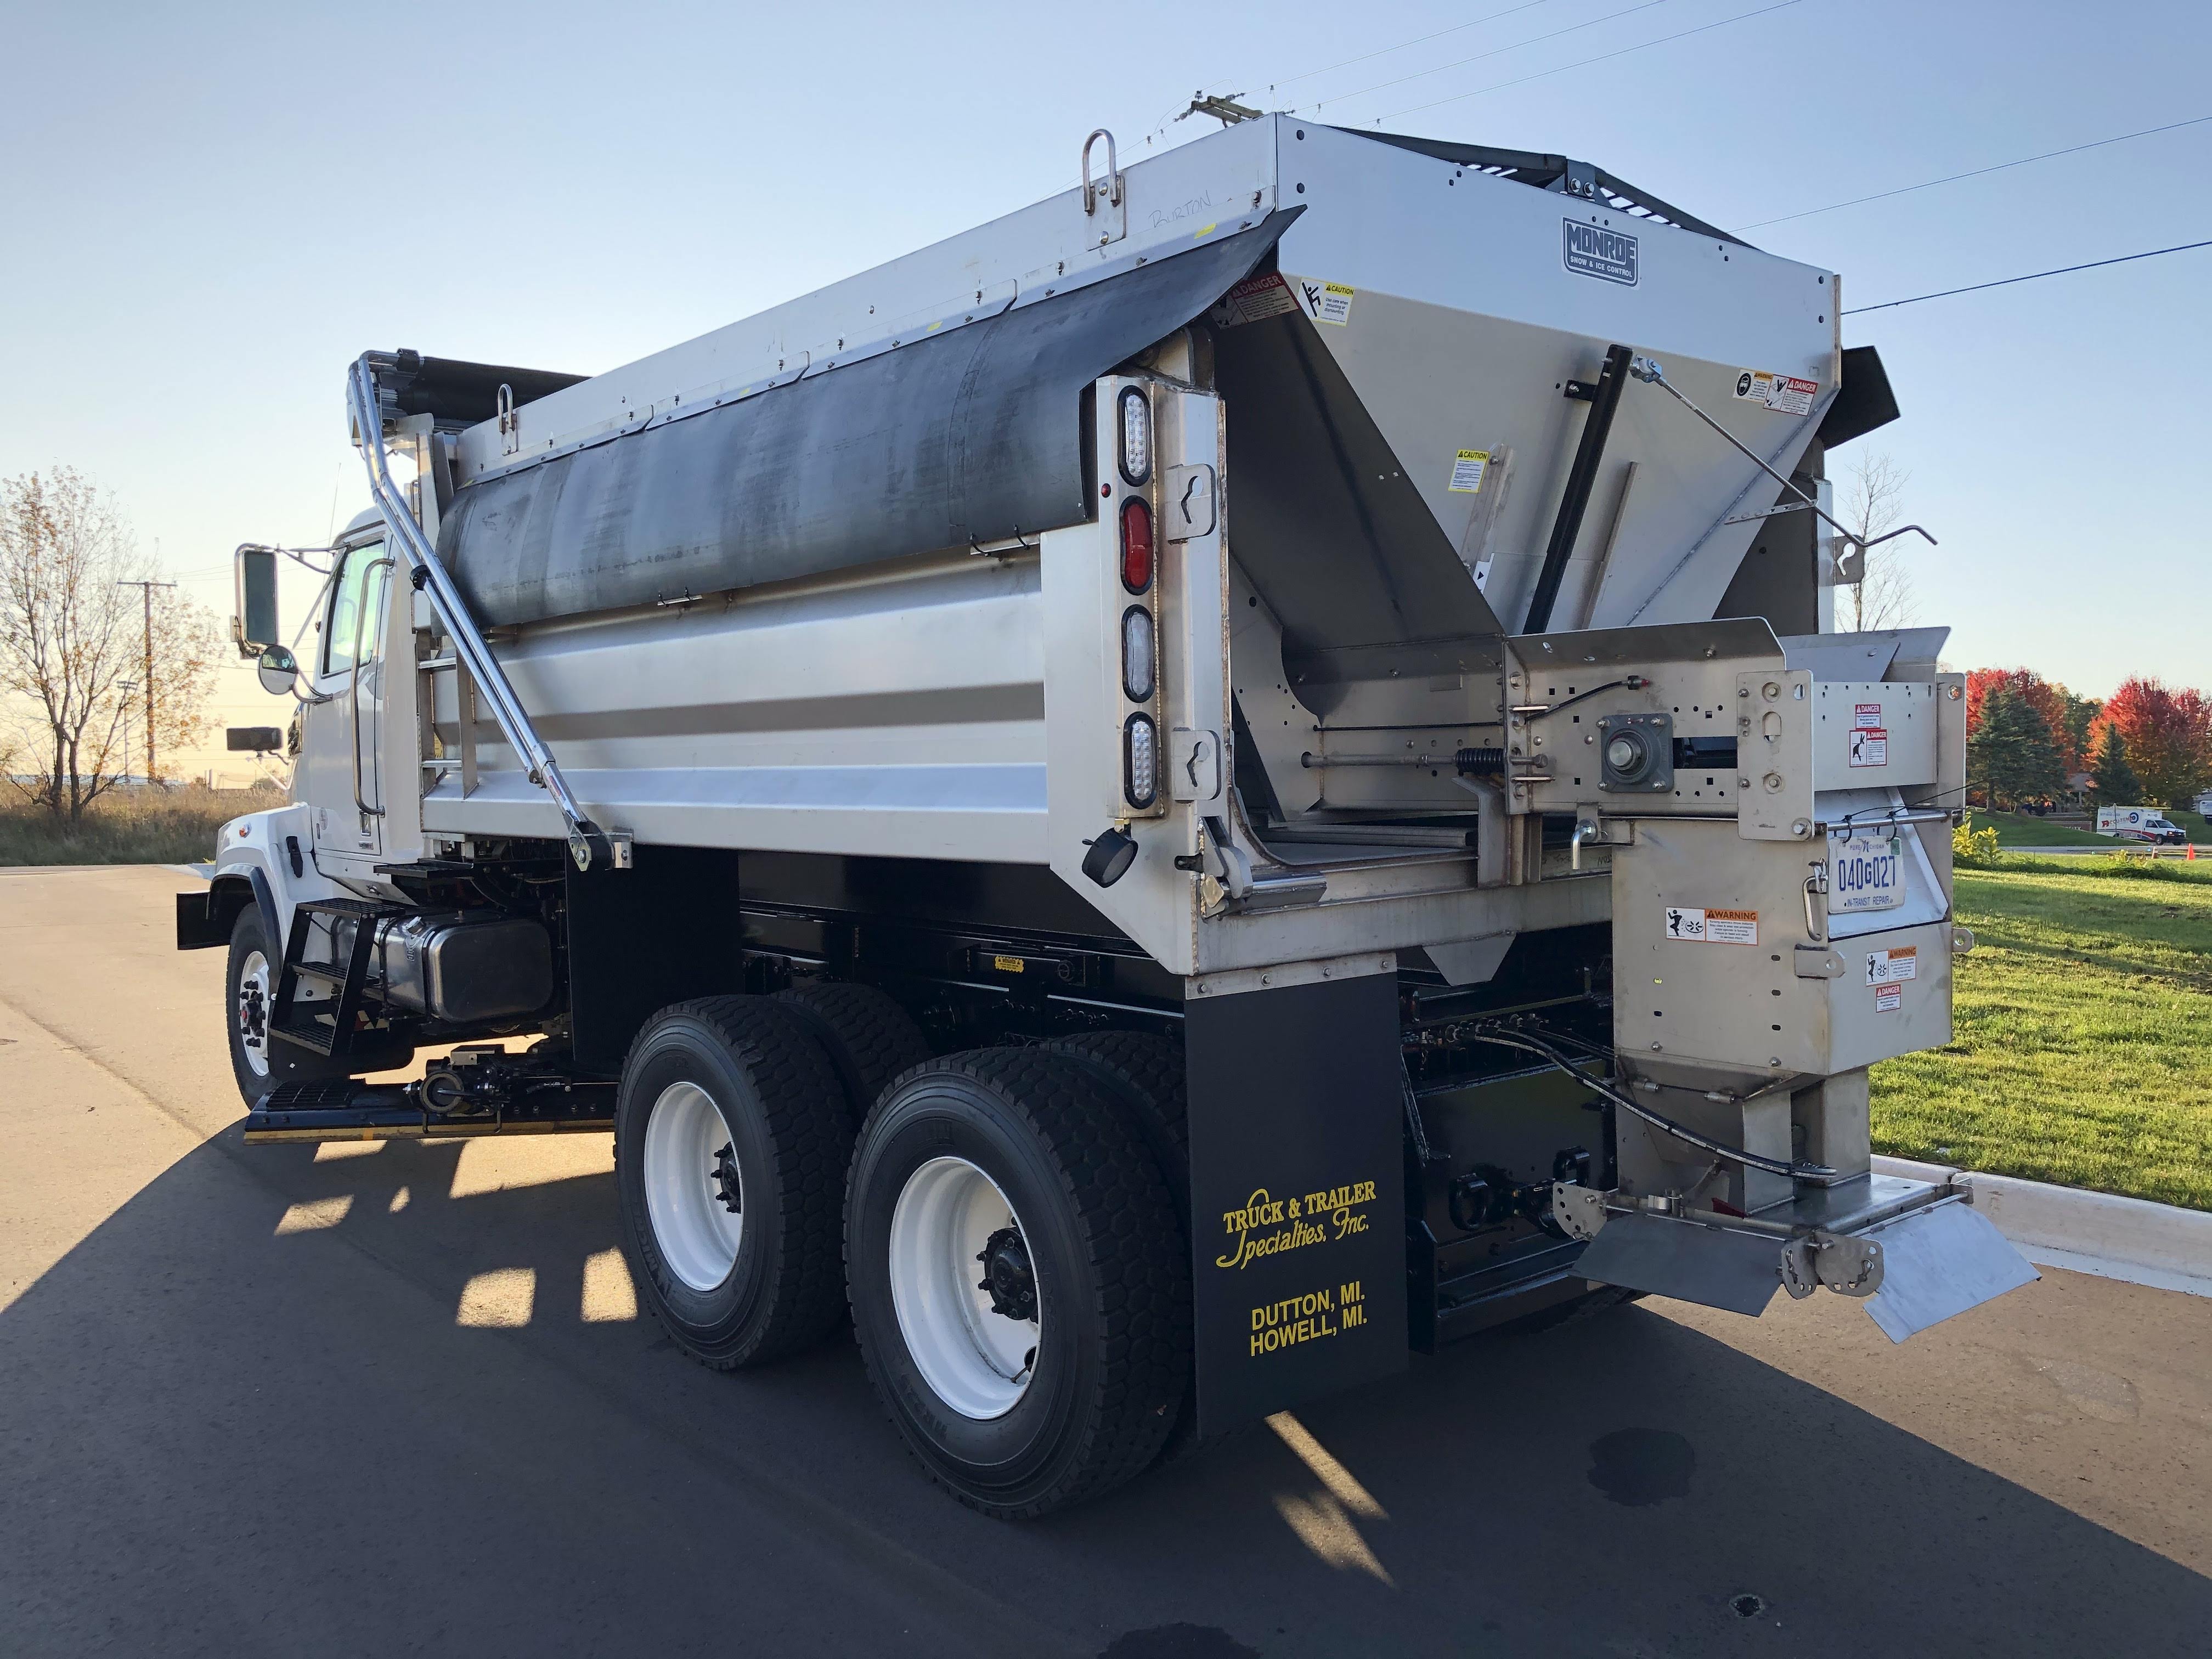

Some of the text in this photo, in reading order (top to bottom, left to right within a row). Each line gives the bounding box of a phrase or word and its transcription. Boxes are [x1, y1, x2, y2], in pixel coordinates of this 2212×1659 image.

[1148, 190, 1211, 228] BURTON
[1567, 223, 1635, 263] MONROE
[1570, 256, 1587, 266] SNOW
[1596, 262, 1605, 270] ICE
[1607, 265, 1633, 278] CONTROL
[1240, 275, 1282, 293] DANGER
[1331, 285, 1354, 295] CAUTION
[1795, 381, 1816, 393] DANGER
[1464, 451, 1488, 460] CAUTION
[1838, 855, 1895, 891] 040G027
[1847, 895, 1889, 907] IN-TRANSIT REPAIR
[1714, 911, 1756, 921] WARNING
[1893, 947, 1916, 956] WARNING
[1882, 986, 1900, 995] DANGER
[1223, 1181, 1376, 1234] TRUCK & TRAILER
[1333, 1207, 1369, 1240] Inc.
[1251, 1280, 1365, 1331] DUTTON, MI.
[1250, 1304, 1368, 1357] HOWELL, MI.
